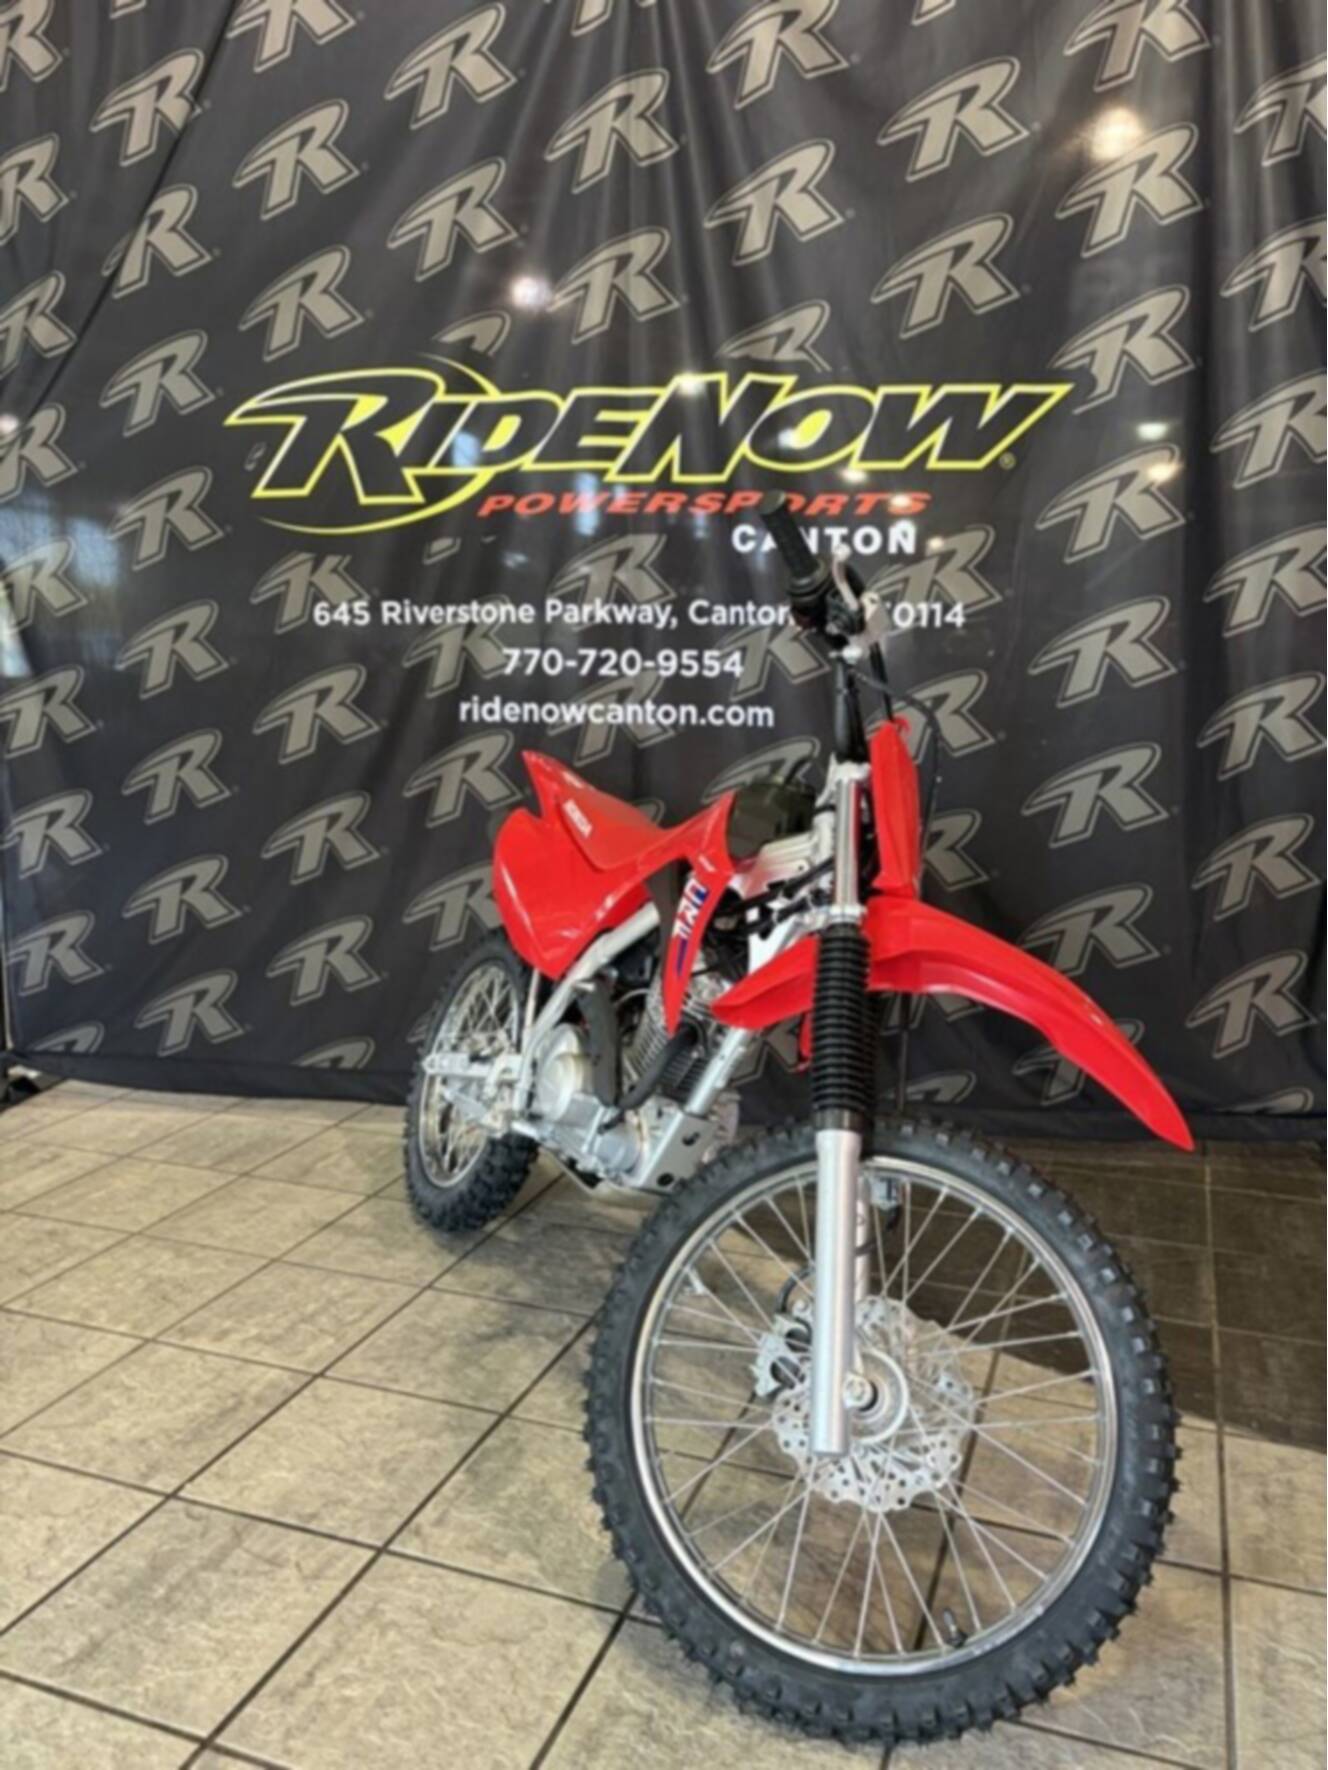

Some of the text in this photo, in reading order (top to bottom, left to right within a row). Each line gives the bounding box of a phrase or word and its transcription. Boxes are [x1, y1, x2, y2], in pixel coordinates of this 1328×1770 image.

[313, 601, 371, 625] 645
[381, 600, 535, 625] Riverstone
[545, 598, 678, 629] Parkway,
[885, 601, 966, 628] 0114
[502, 648, 744, 678] 770-720-9554
[459, 694, 775, 727] ridenowcanton.com
